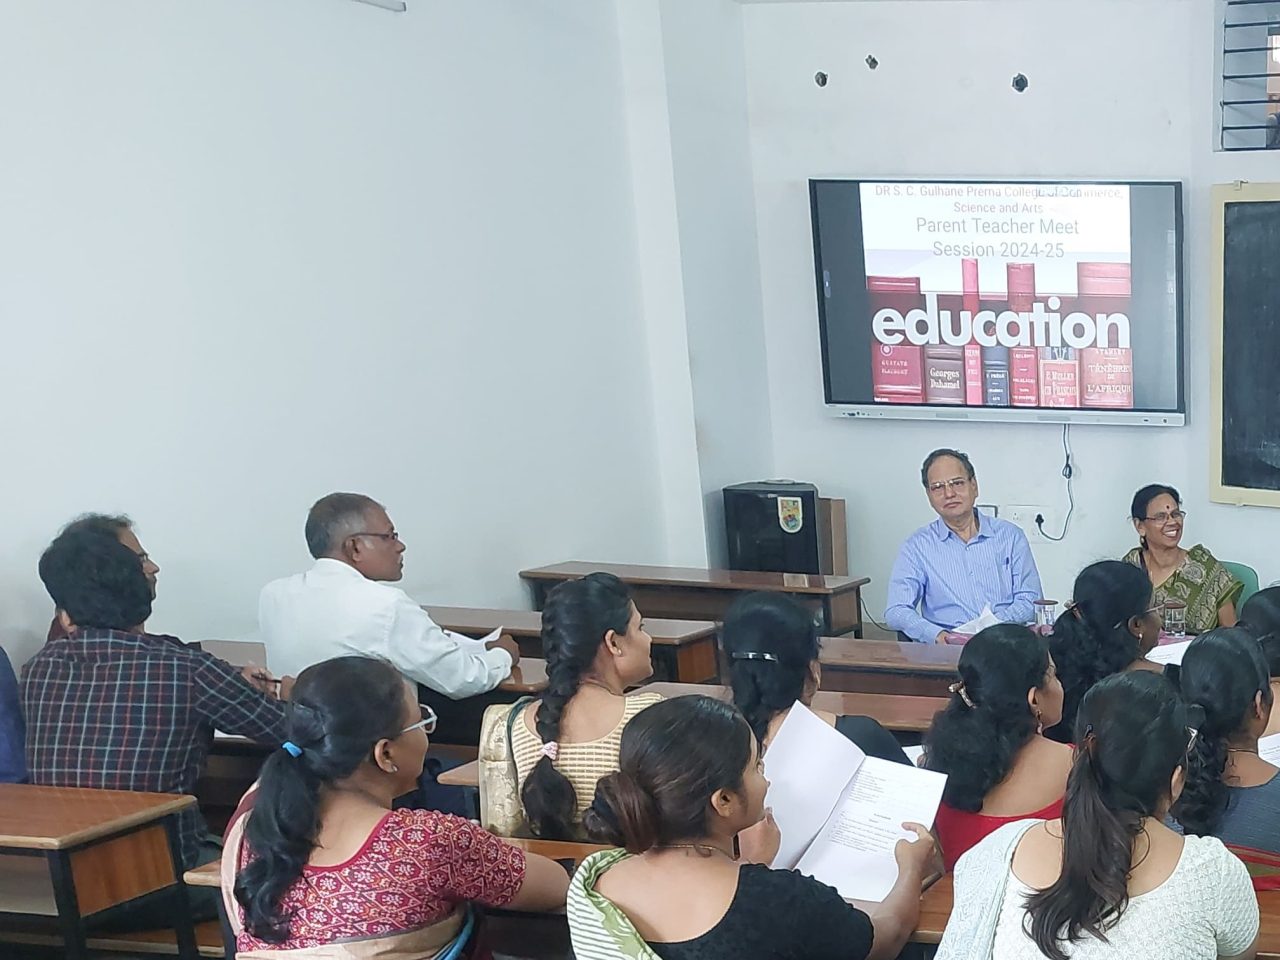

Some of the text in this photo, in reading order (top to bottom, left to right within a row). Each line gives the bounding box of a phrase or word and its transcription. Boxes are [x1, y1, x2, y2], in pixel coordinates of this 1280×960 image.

[875, 185, 891, 196] DR
[920, 185, 963, 197] Gulhane
[954, 201, 1044, 214] Science and Arts
[916, 217, 1080, 235] Parent Teacher Meet
[933, 241, 1065, 258] Session 2024-25
[871, 291, 1131, 349] education
[929, 367, 960, 380] Georges
